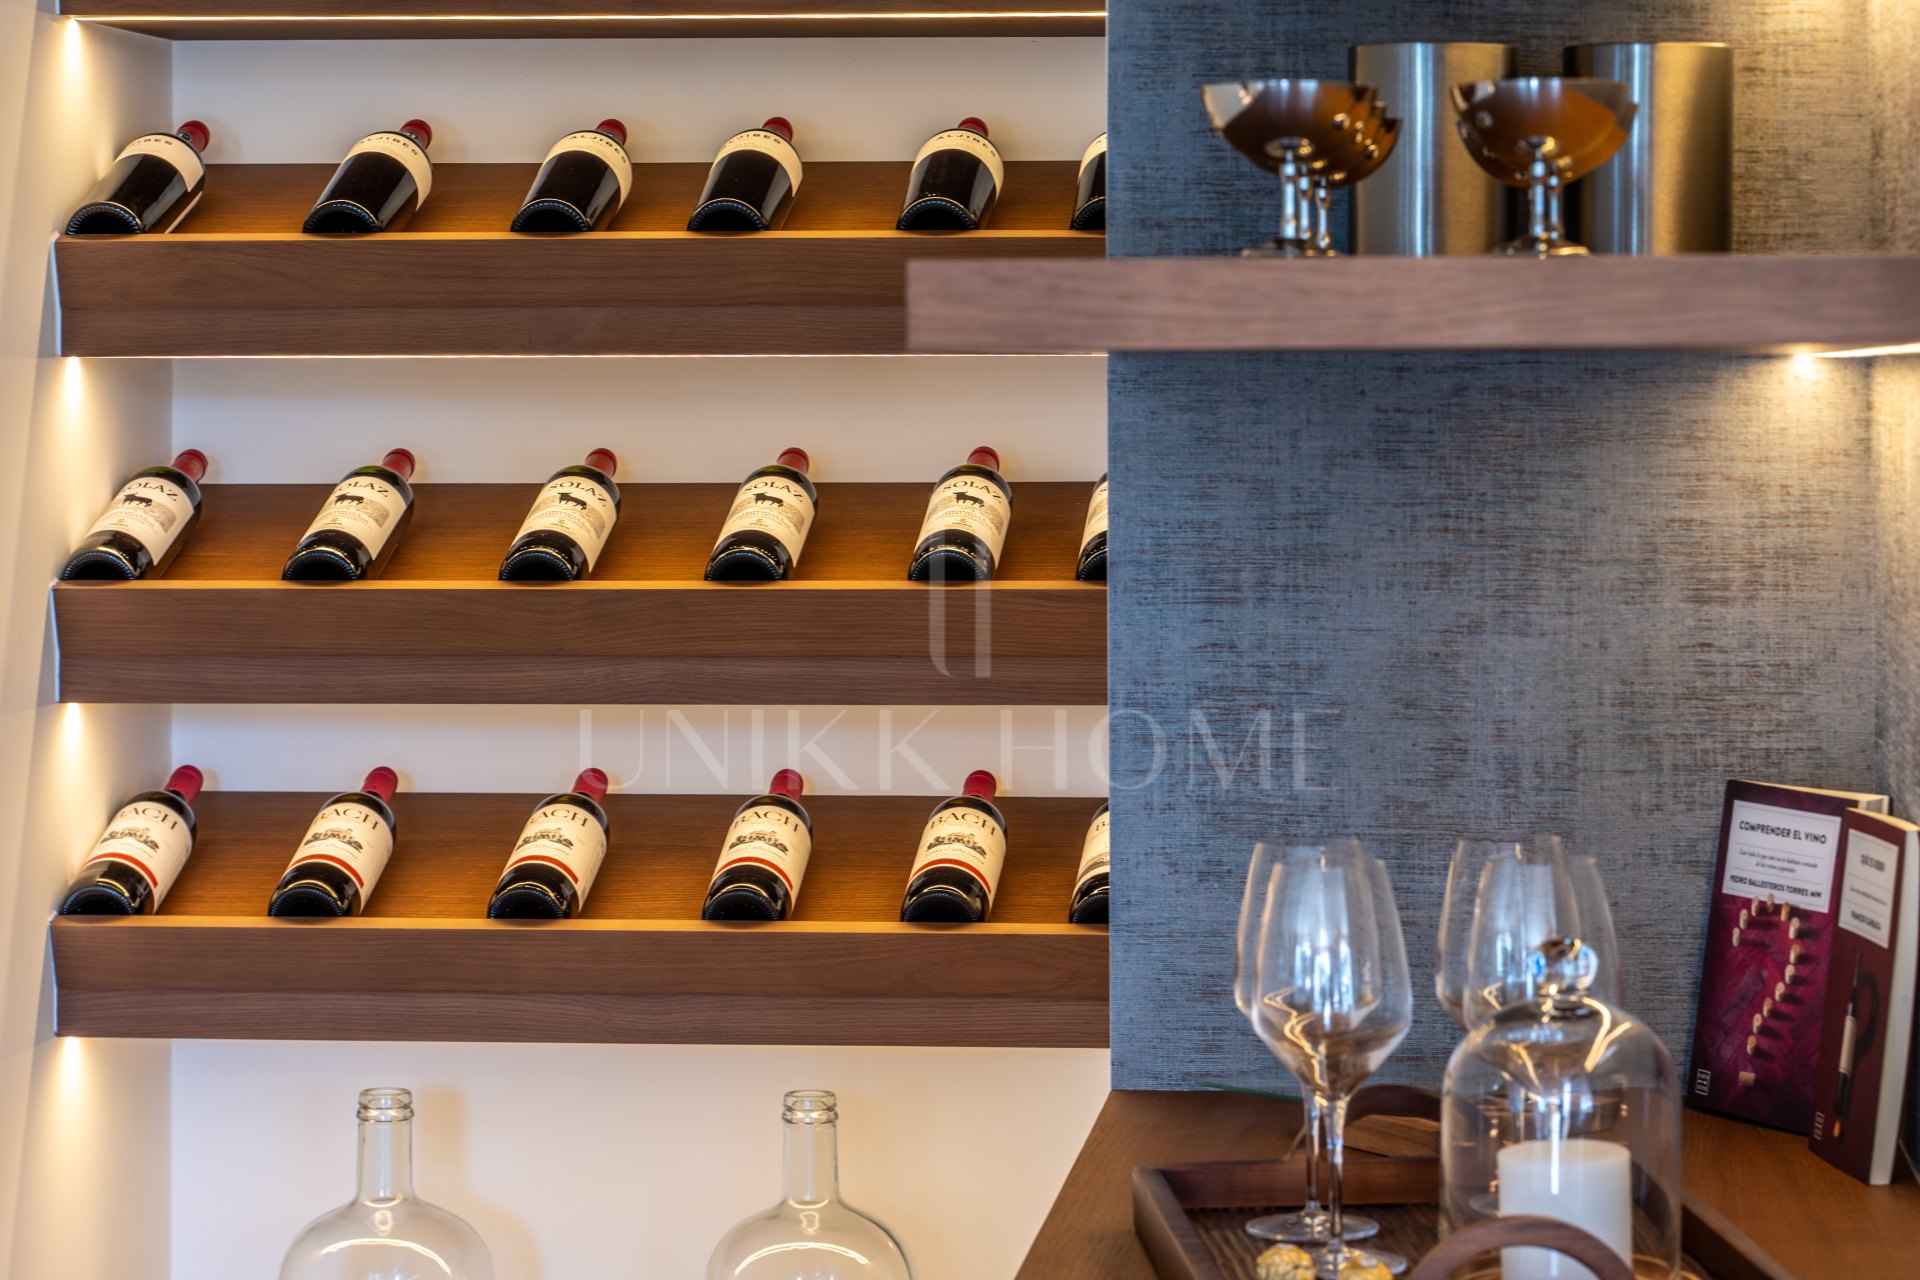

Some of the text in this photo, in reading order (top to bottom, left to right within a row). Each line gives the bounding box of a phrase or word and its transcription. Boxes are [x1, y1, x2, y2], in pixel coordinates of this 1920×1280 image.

[121, 481, 179, 502] OLAZ
[334, 481, 390, 498] OLAZ
[547, 480, 608, 507] SOLAZ
[742, 480, 804, 503] SOLAZ
[941, 480, 1003, 504] SOLAZ
[733, 810, 800, 833] BACH
[930, 812, 997, 836] BACH
[1739, 820, 1828, 845] COMPRENDER EL VINO
[1729, 874, 1748, 885] PEDRO
[1748, 878, 1785, 893] BALLESTEROS
[1786, 885, 1809, 897] TORRES
